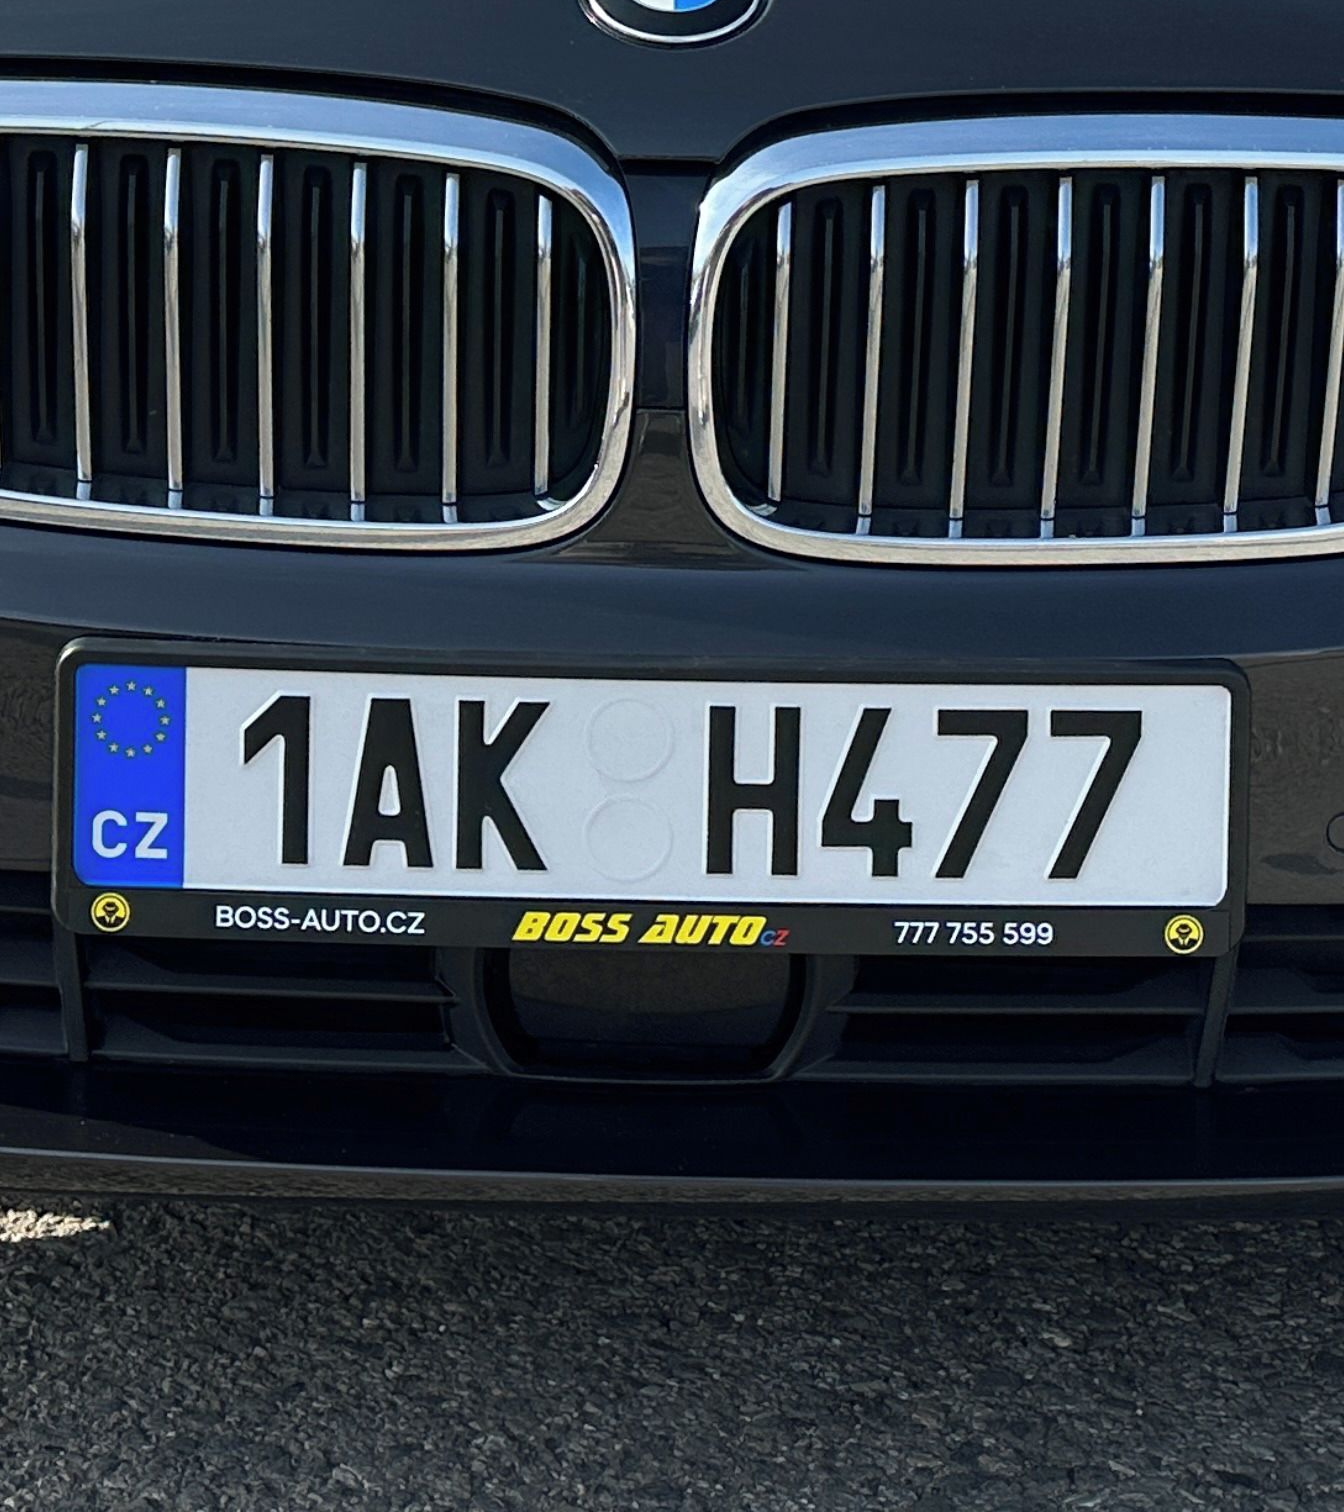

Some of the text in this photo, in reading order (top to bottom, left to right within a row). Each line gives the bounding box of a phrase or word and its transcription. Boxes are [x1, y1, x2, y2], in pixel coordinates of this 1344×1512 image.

[241, 692, 1144, 880] 1AK H477
[91, 809, 169, 860] CZ
[215, 904, 426, 935] BOSS-AUTO.CZ
[512, 911, 633, 943] BOSS
[894, 921, 1055, 946] 777 755 599
